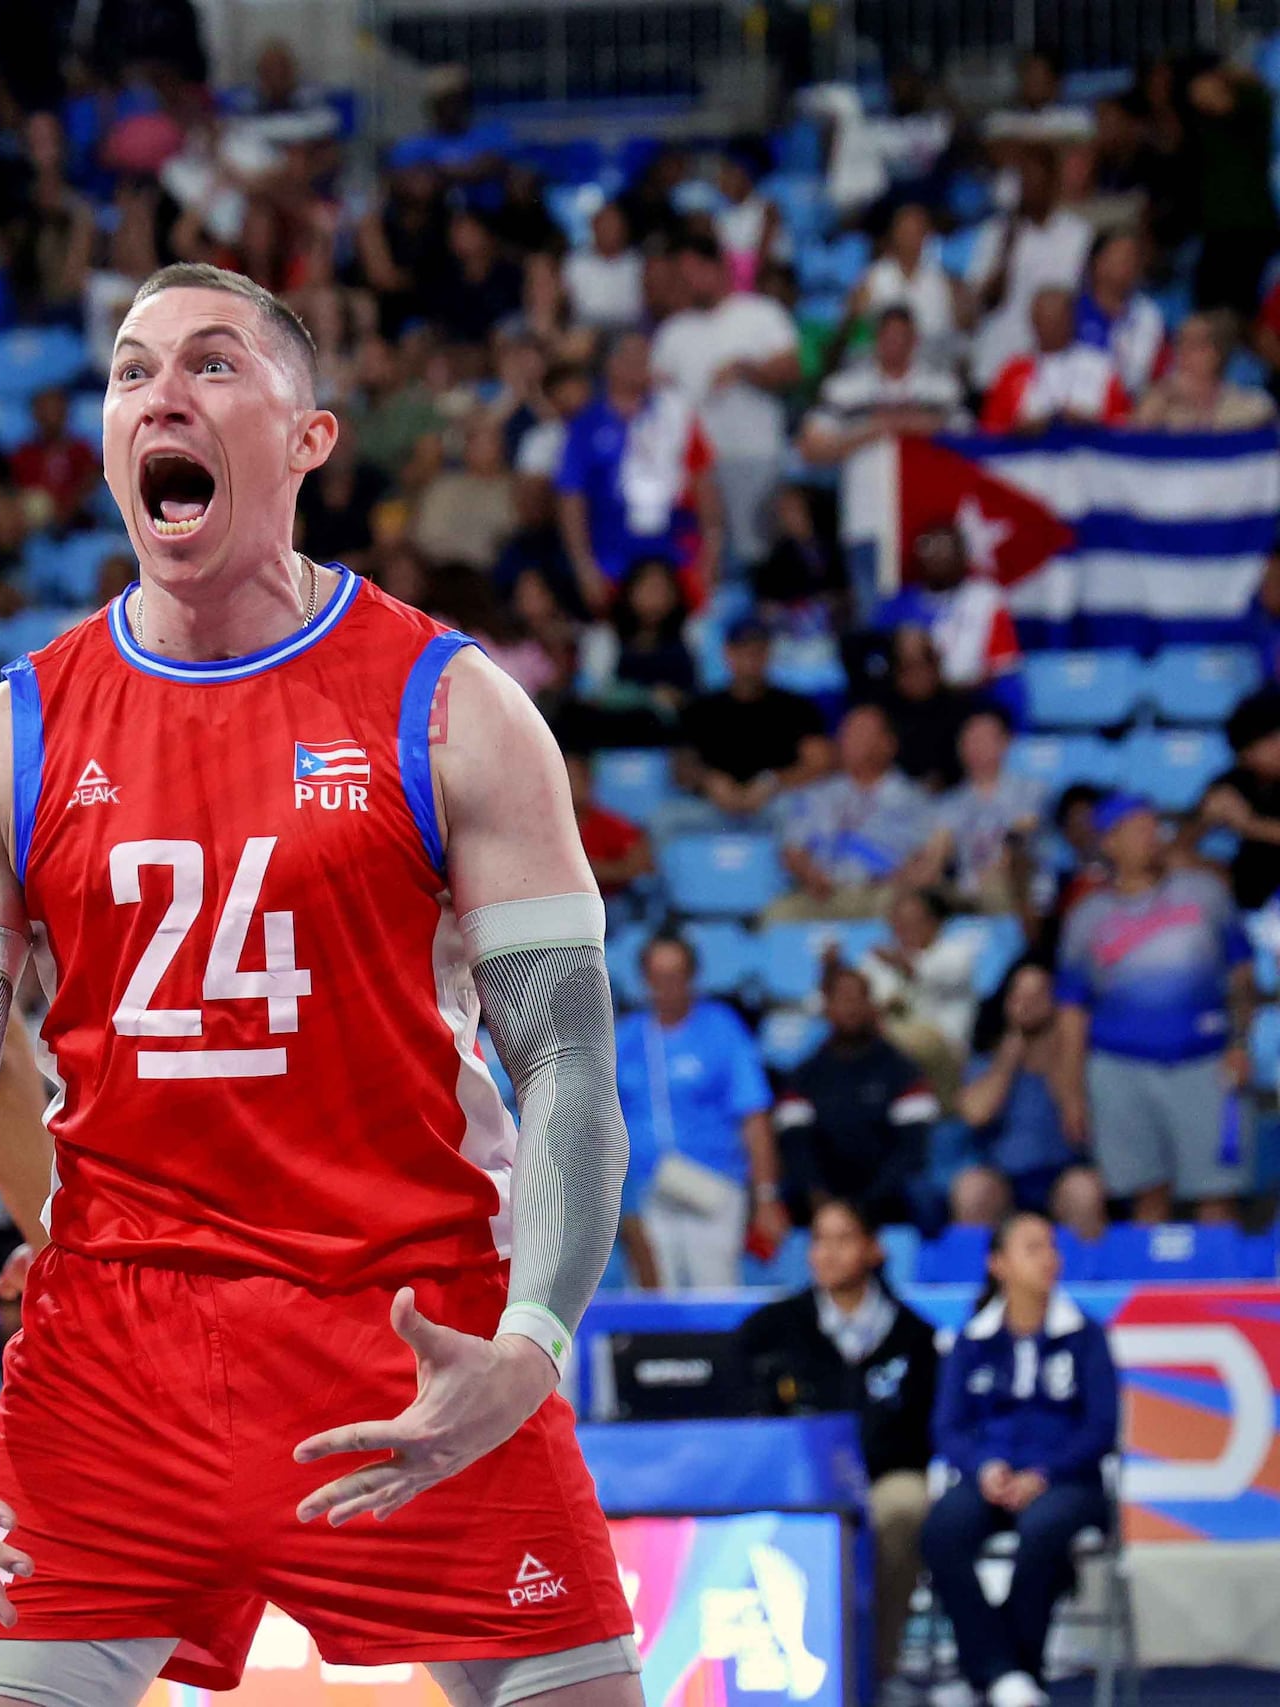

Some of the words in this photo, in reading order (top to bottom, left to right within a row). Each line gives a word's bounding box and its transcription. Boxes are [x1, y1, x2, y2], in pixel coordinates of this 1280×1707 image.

[66, 785, 123, 809] PEAK
[294, 782, 369, 812] PUR
[109, 836, 312, 1037] 24
[507, 1576, 569, 1607] PEAK
